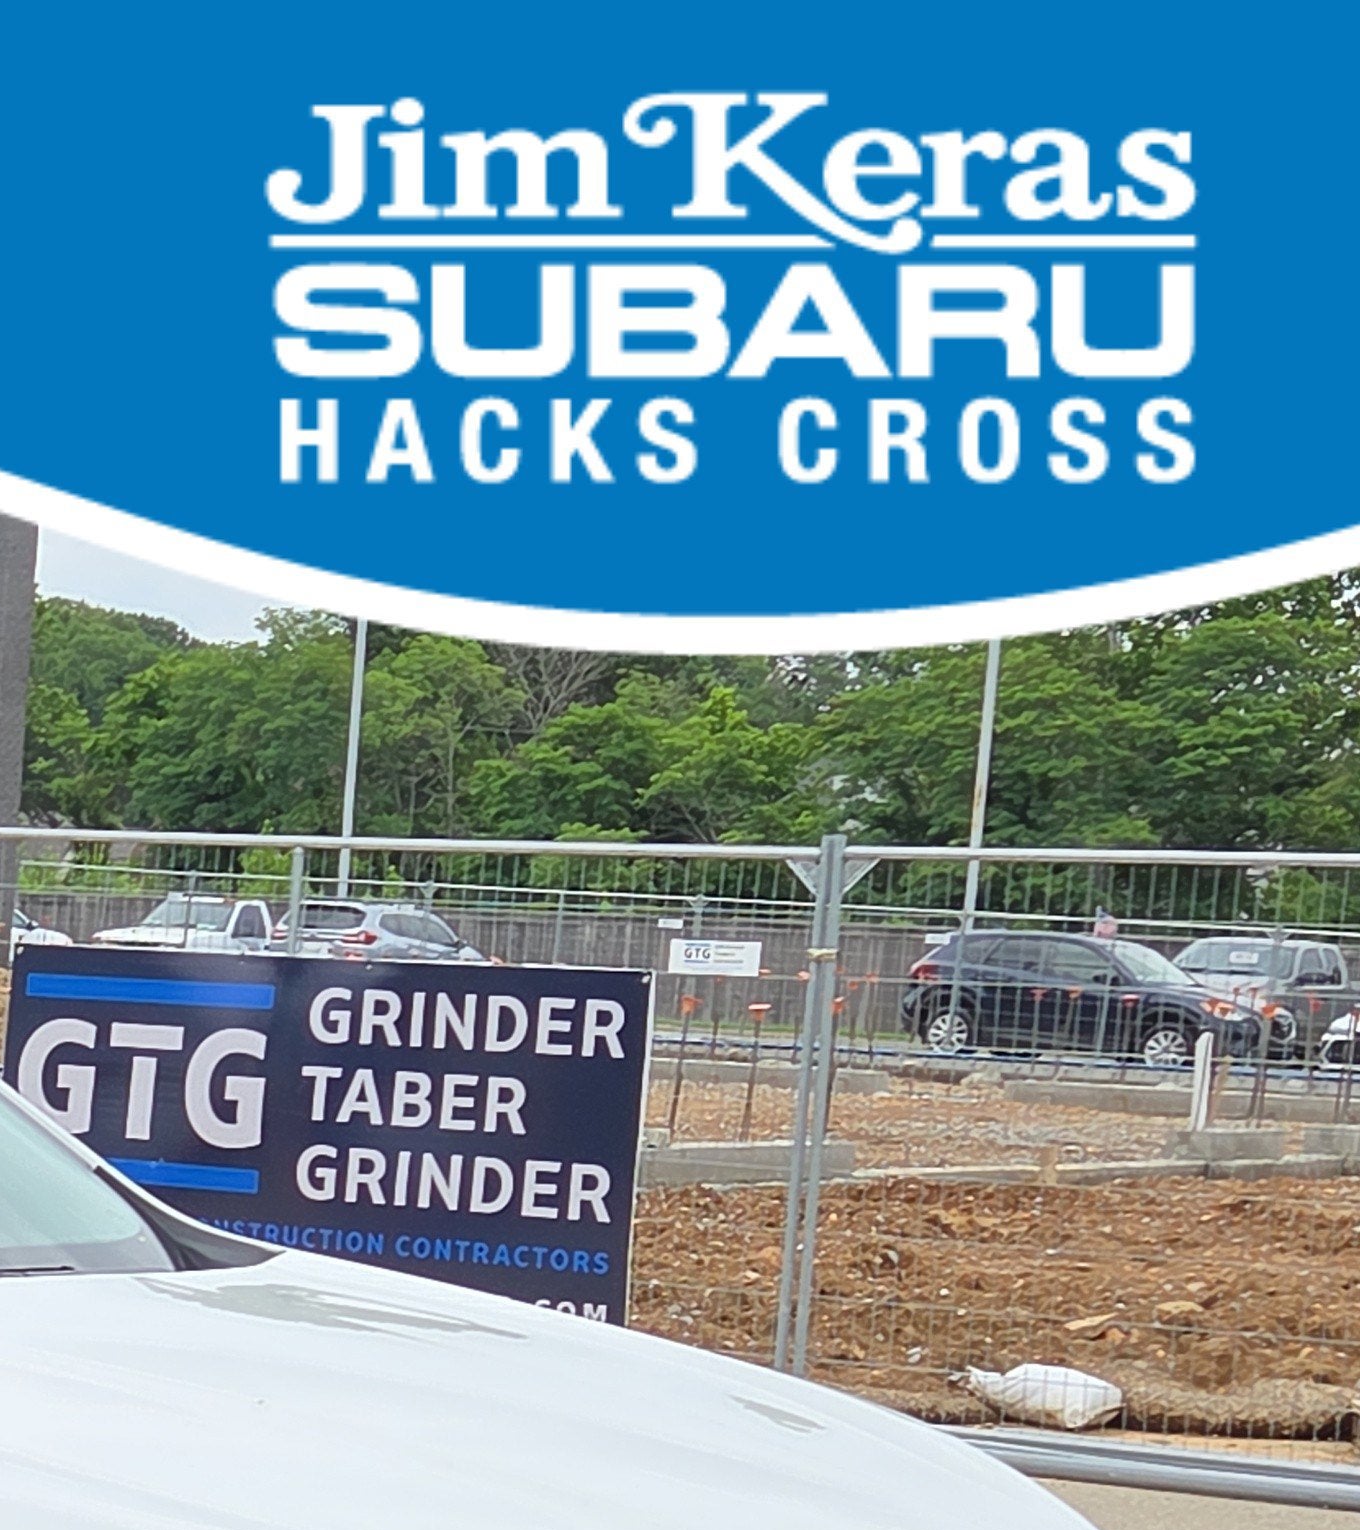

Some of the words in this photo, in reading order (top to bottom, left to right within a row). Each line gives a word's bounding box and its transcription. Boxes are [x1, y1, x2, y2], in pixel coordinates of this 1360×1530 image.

[309, 986, 626, 1060] GRINDER
[17, 1017, 268, 1149] GTG
[300, 1064, 527, 1135] TABER
[295, 1144, 612, 1224] GRINDER
[394, 1234, 610, 1275] CONTRACTORS
